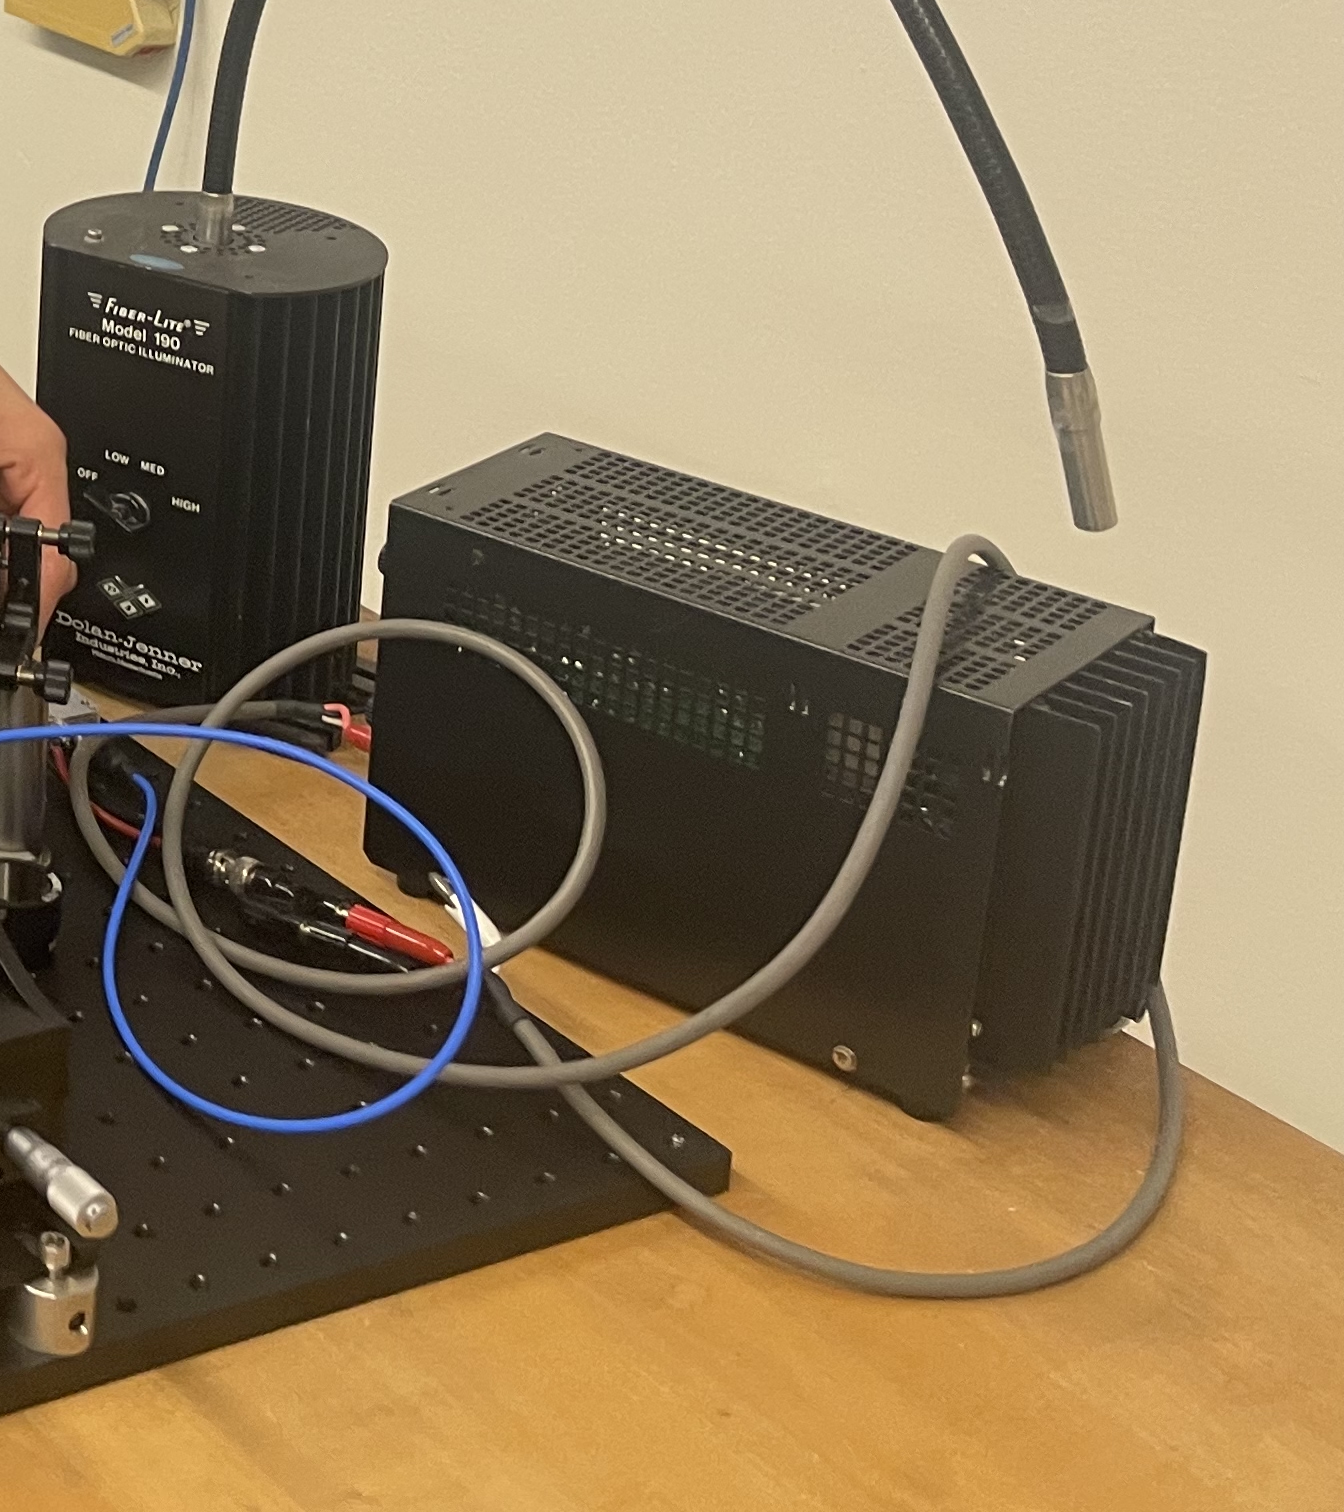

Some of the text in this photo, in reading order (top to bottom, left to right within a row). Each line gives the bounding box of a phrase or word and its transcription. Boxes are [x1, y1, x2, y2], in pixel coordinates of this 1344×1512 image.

[102, 317, 181, 352] Model 190
[69, 327, 215, 376] FIBER OPTIC ILLUMINATOR
[77, 467, 98, 481] OFF
[105, 449, 165, 476] LOW MED
[172, 496, 200, 514] HIGH
[55, 609, 203, 673] Dolan-Jenner
